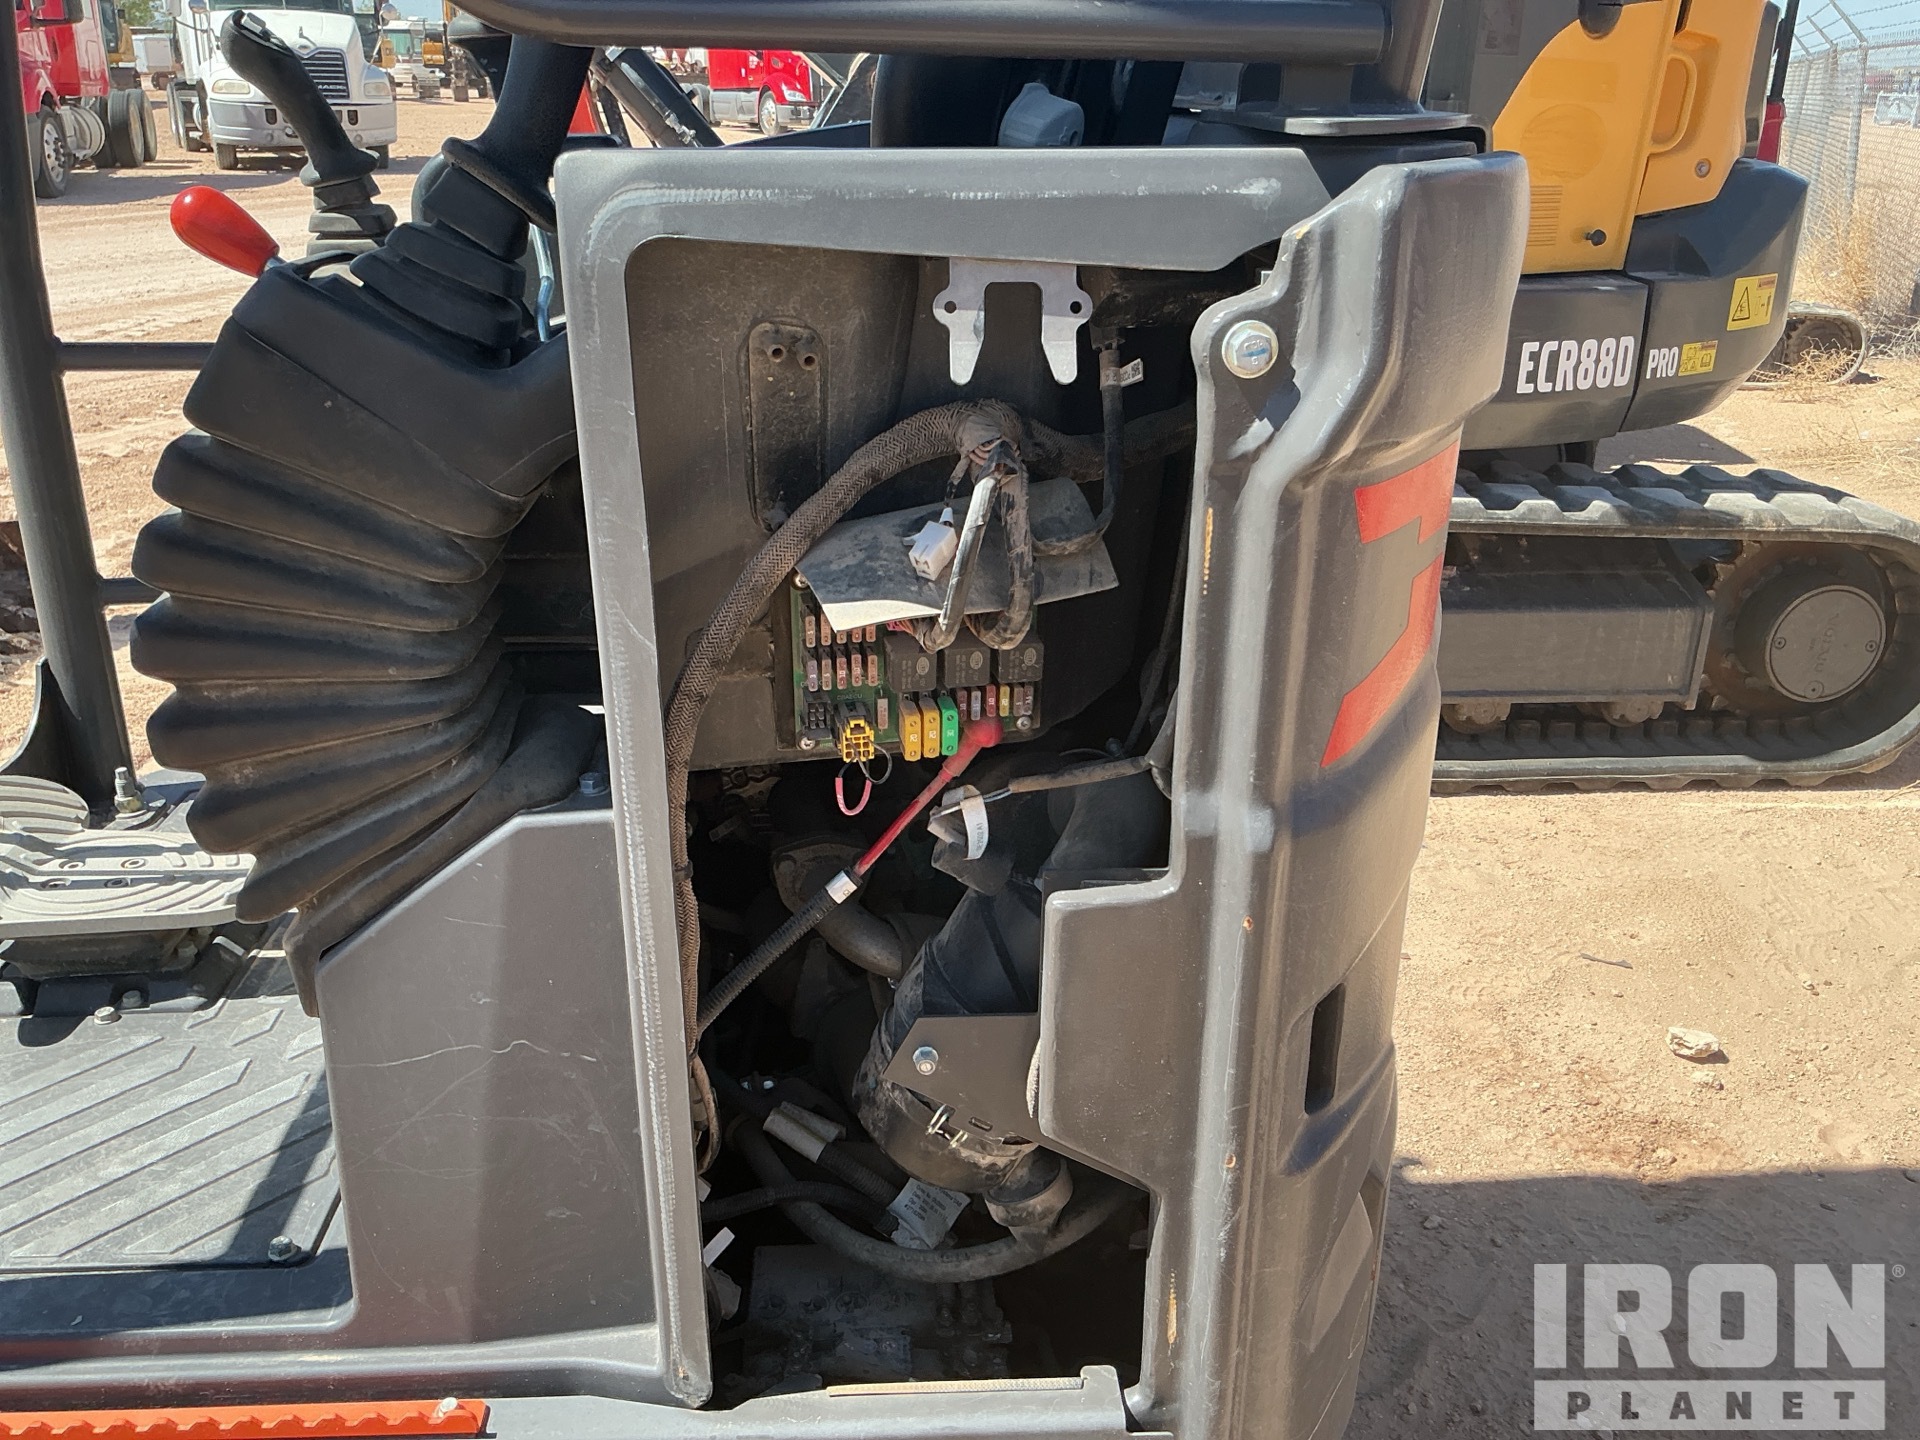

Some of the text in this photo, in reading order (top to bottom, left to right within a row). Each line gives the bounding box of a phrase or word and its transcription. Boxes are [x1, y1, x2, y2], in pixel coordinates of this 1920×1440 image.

[1516, 335, 1679, 394] ECR88D PRO
[839, 670, 846, 678] 10
[988, 697, 995, 705] 10
[1001, 699, 1008, 707] 20
